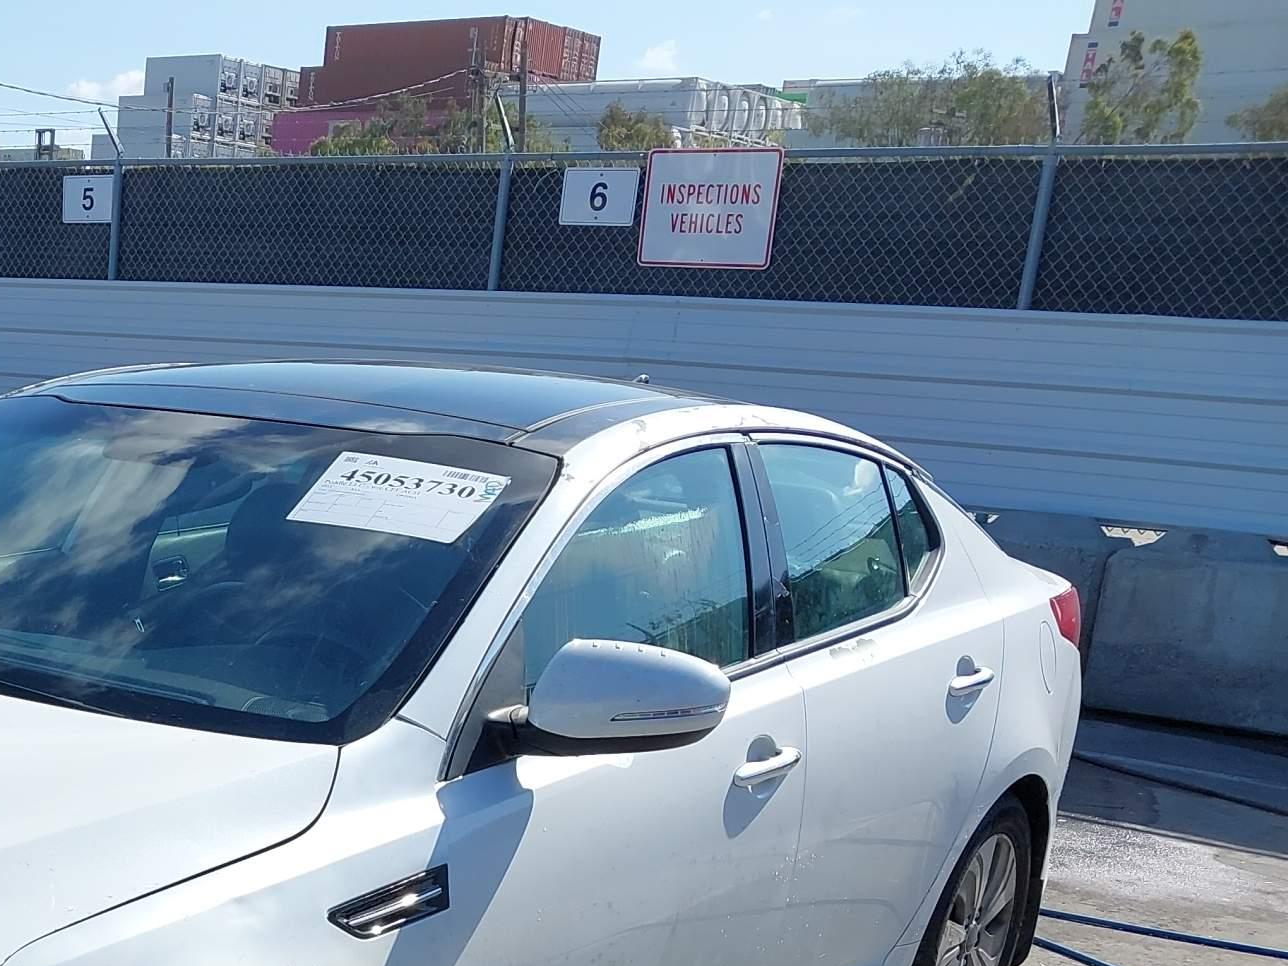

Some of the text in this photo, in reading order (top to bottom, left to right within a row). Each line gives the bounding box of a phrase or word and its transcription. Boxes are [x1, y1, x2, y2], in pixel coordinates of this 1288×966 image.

[82, 187, 94, 211] 5
[589, 182, 609, 212] 6
[660, 183, 762, 205] INSPECTIONS
[670, 213, 744, 234] VEHICLES
[340, 468, 476, 499] 45053730
